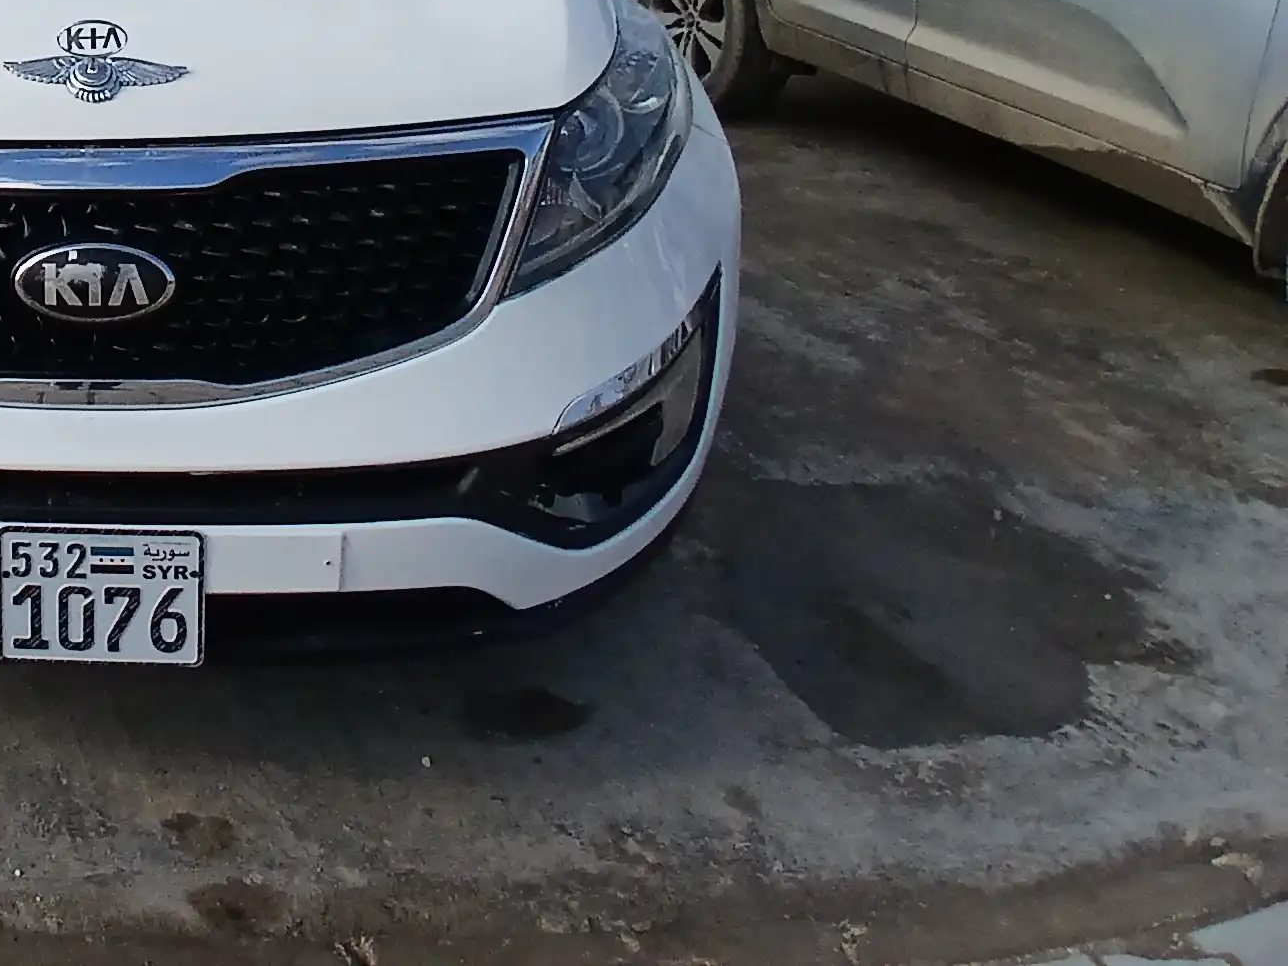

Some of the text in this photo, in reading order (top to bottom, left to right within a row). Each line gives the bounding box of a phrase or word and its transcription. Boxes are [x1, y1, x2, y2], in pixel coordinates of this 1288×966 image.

[65, 27, 122, 51] KIA
[41, 262, 150, 307] KIA
[11, 541, 88, 579] 532
[142, 543, 190, 562] سورية
[142, 564, 189, 580] SYR
[12, 585, 188, 653] 1076
